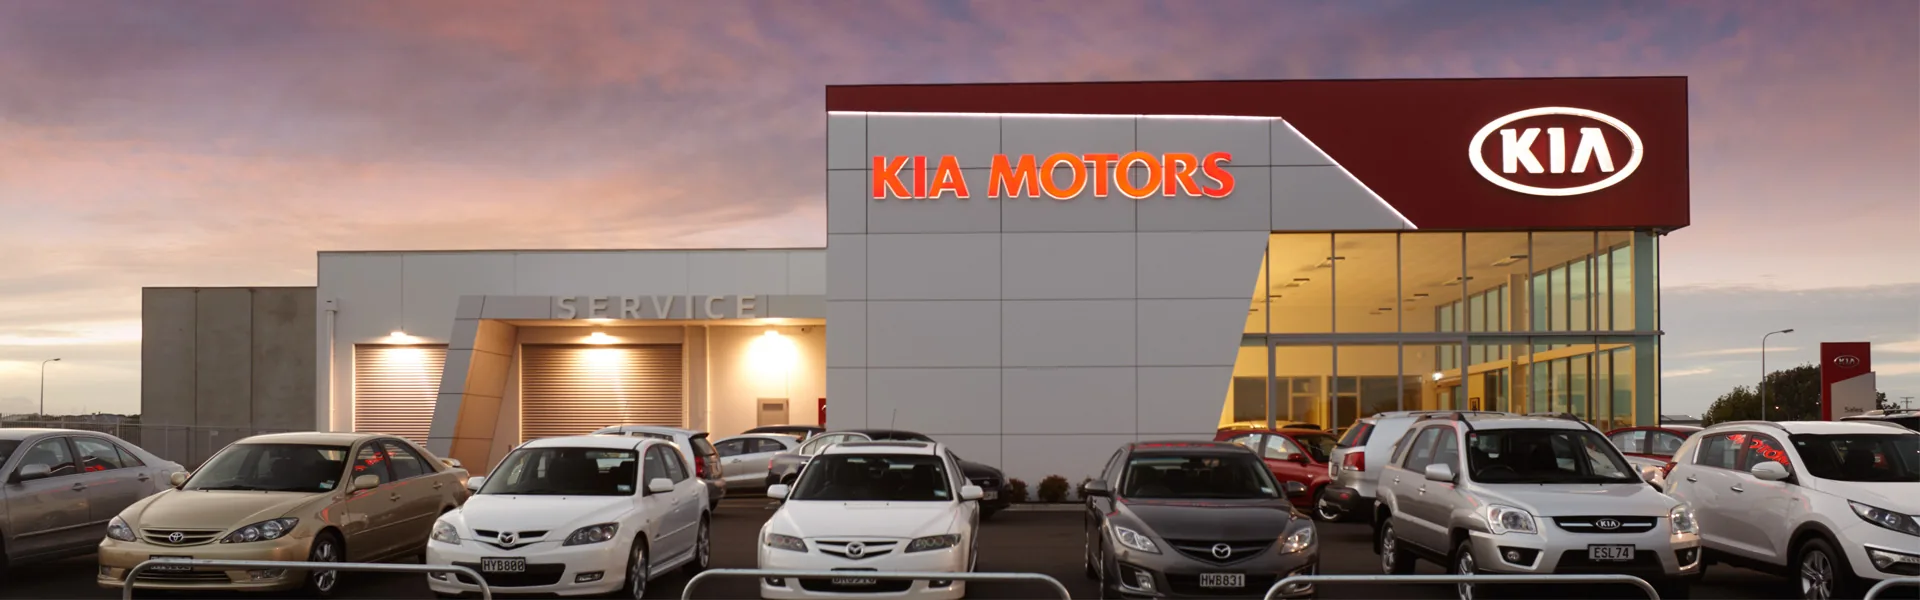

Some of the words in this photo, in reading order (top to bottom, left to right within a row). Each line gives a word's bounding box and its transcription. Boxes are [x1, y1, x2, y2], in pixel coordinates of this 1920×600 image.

[1500, 127, 1615, 174] KIA
[873, 155, 970, 199] KIA
[988, 151, 1235, 199] MOTORS
[557, 295, 757, 320] SERVICE
[1594, 547, 1629, 558] ESL74
[1201, 574, 1243, 586] HWB831
